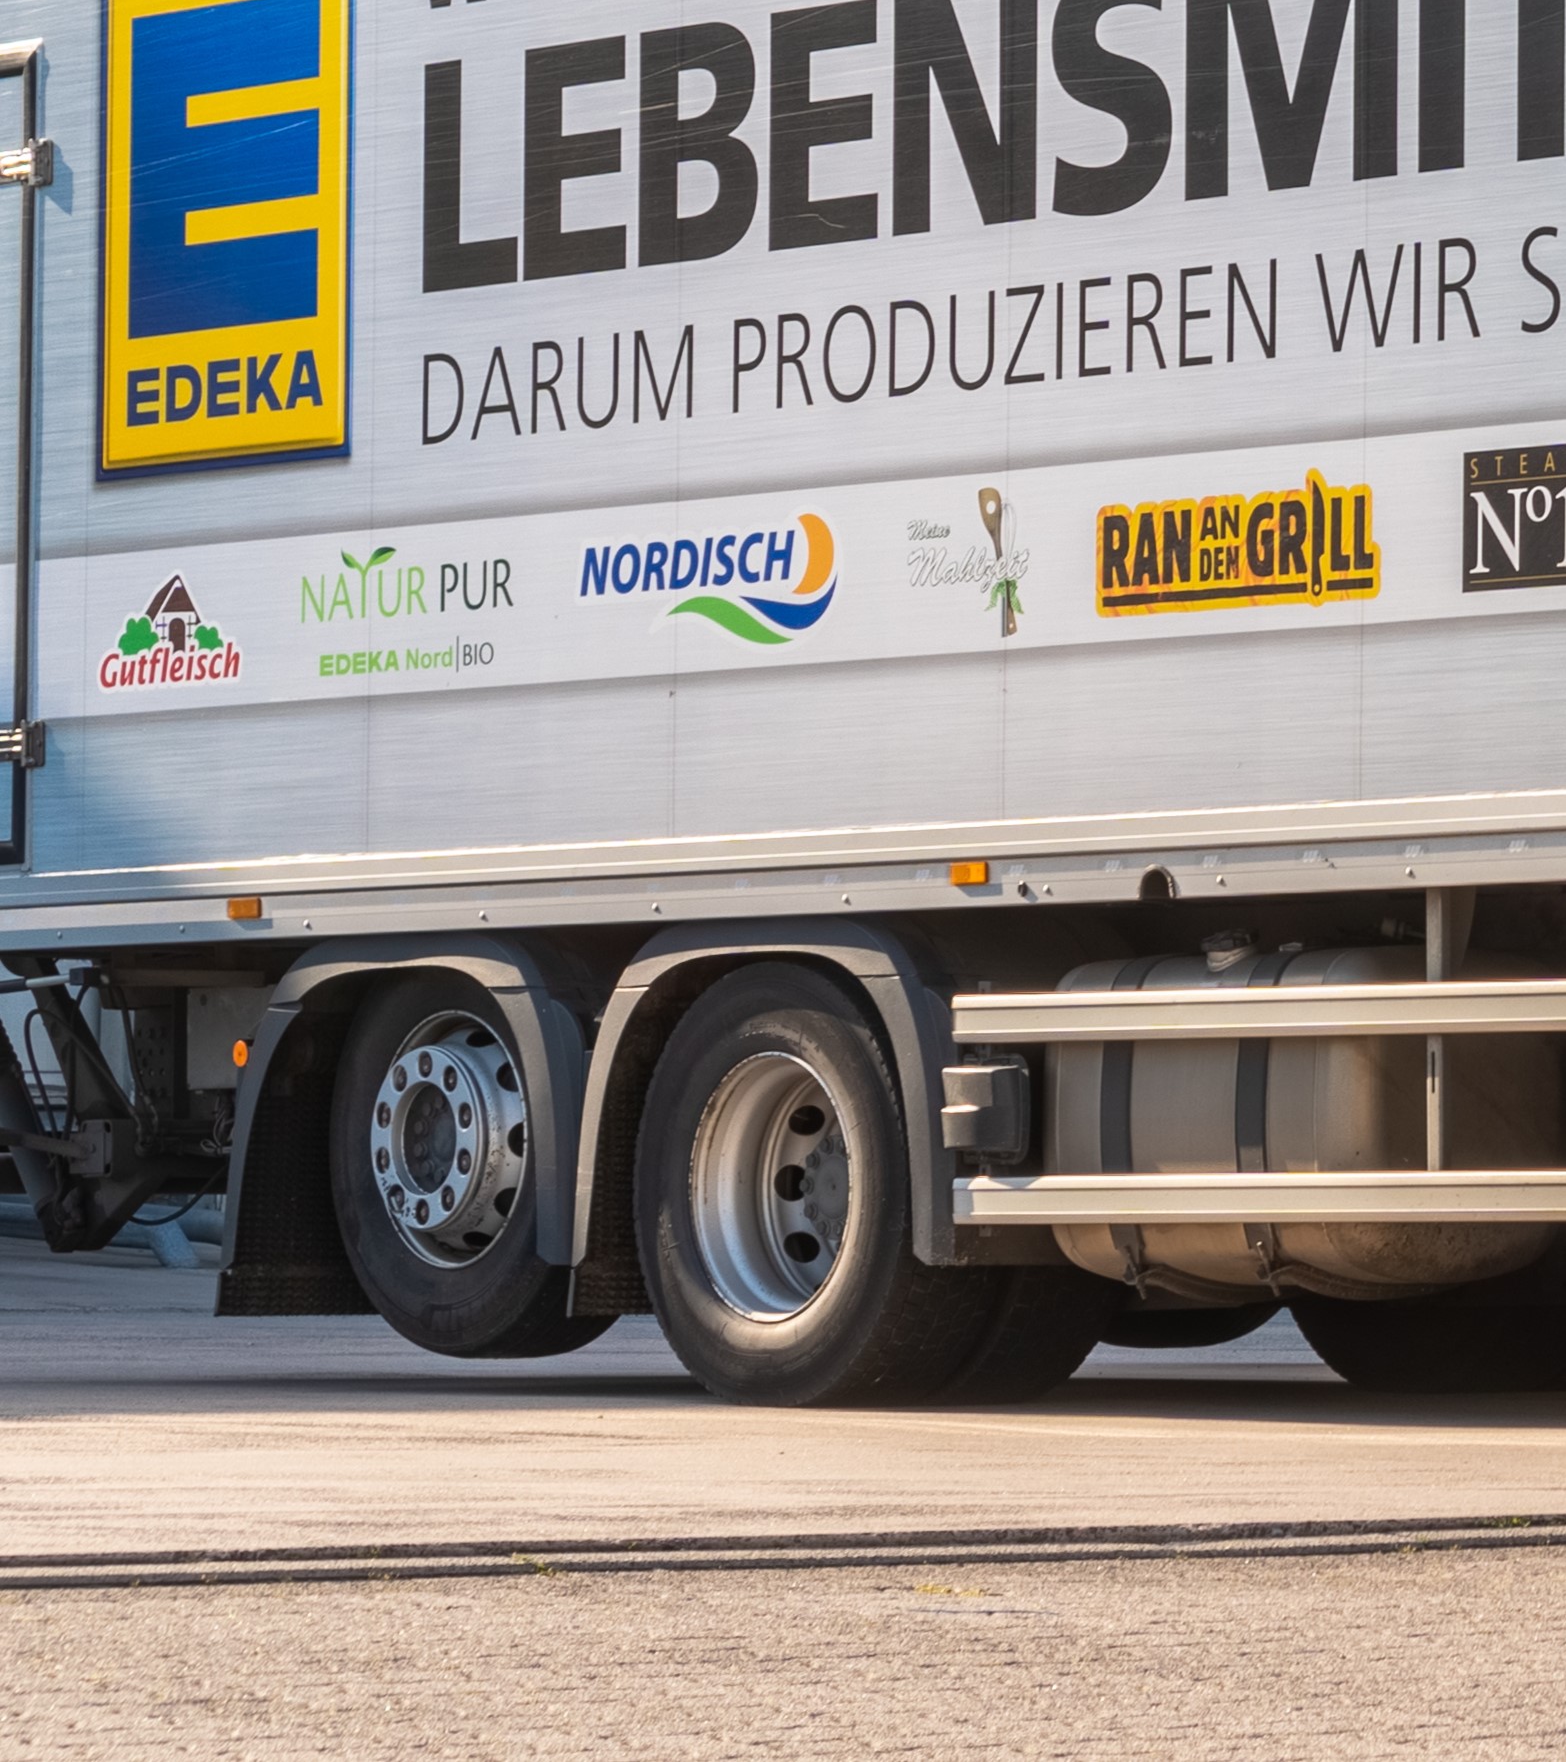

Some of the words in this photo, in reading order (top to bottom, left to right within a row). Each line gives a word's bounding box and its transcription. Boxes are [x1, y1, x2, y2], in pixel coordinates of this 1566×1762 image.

[421, 325, 694, 445] DARUM
[732, 260, 1278, 413] PRODUZIEREN
[1316, 238, 1481, 353] WIR
[126, 350, 322, 427] EDEKA
[908, 519, 951, 541] Meine
[1102, 509, 1192, 588] RAN
[1247, 483, 1374, 590] GRILL
[1200, 504, 1240, 540] AN
[580, 529, 796, 597] NORDISCH
[908, 546, 1030, 592] Mahlzeit
[1200, 545, 1240, 581] DEN
[301, 552, 427, 624] NATUR
[440, 558, 514, 613] PUR
[100, 643, 240, 688] Gutfleisch
[319, 649, 400, 677] EDEKA
